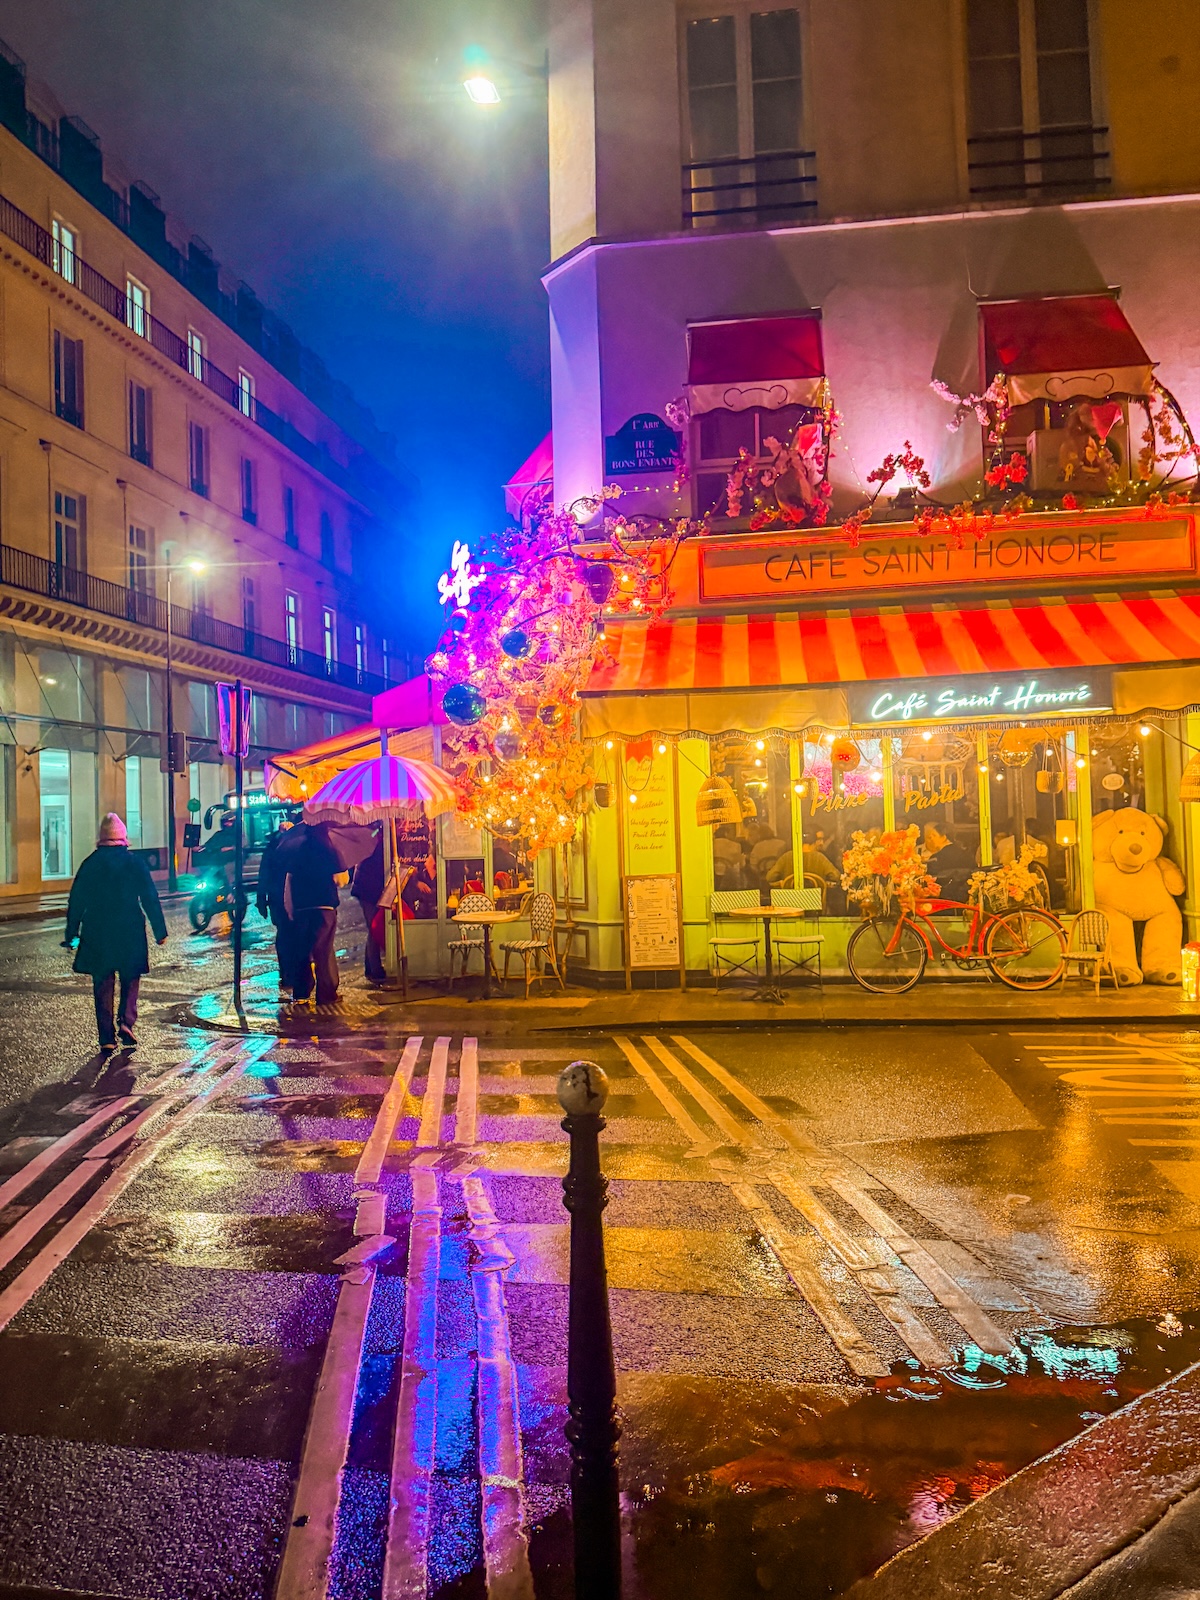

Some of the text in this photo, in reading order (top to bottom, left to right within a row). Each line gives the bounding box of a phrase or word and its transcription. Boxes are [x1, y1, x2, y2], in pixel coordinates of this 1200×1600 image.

[635, 440, 654, 449] RUE
[636, 449, 654, 458] DES
[612, 457, 674, 469] BONS ENFANT
[765, 532, 1119, 582] CAFE SAINT HONORE
[871, 680, 1092, 720] Café Saint Honoré
[904, 784, 964, 813] Pasta
